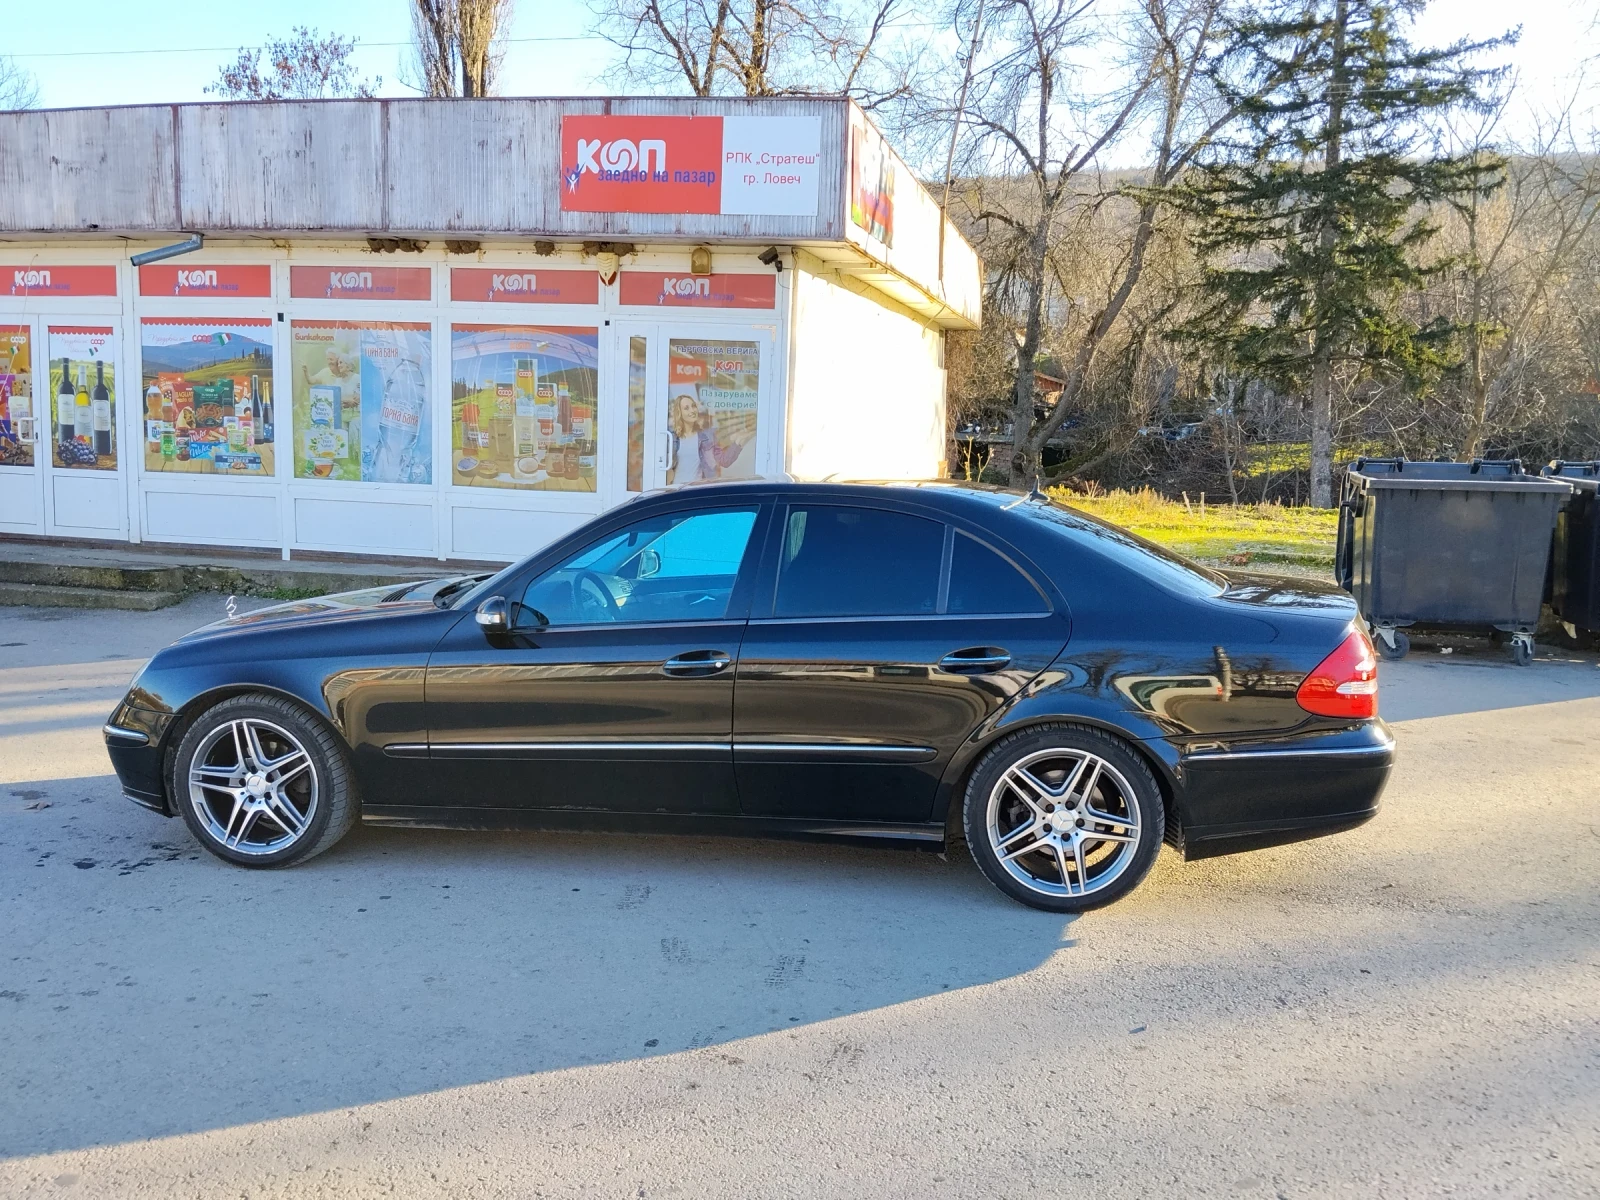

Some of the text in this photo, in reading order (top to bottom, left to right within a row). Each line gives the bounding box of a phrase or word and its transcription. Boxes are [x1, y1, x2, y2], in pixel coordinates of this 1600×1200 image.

[726, 152, 752, 164] РПК
[598, 169, 716, 187] заедно на пазар
[743, 173, 801, 186] гр. Ловеч
[675, 345, 758, 355] ТЪРГОВСКА ВЕРИГА
[701, 389, 757, 399] Пазаруваме
[714, 401, 757, 409] доверие!
